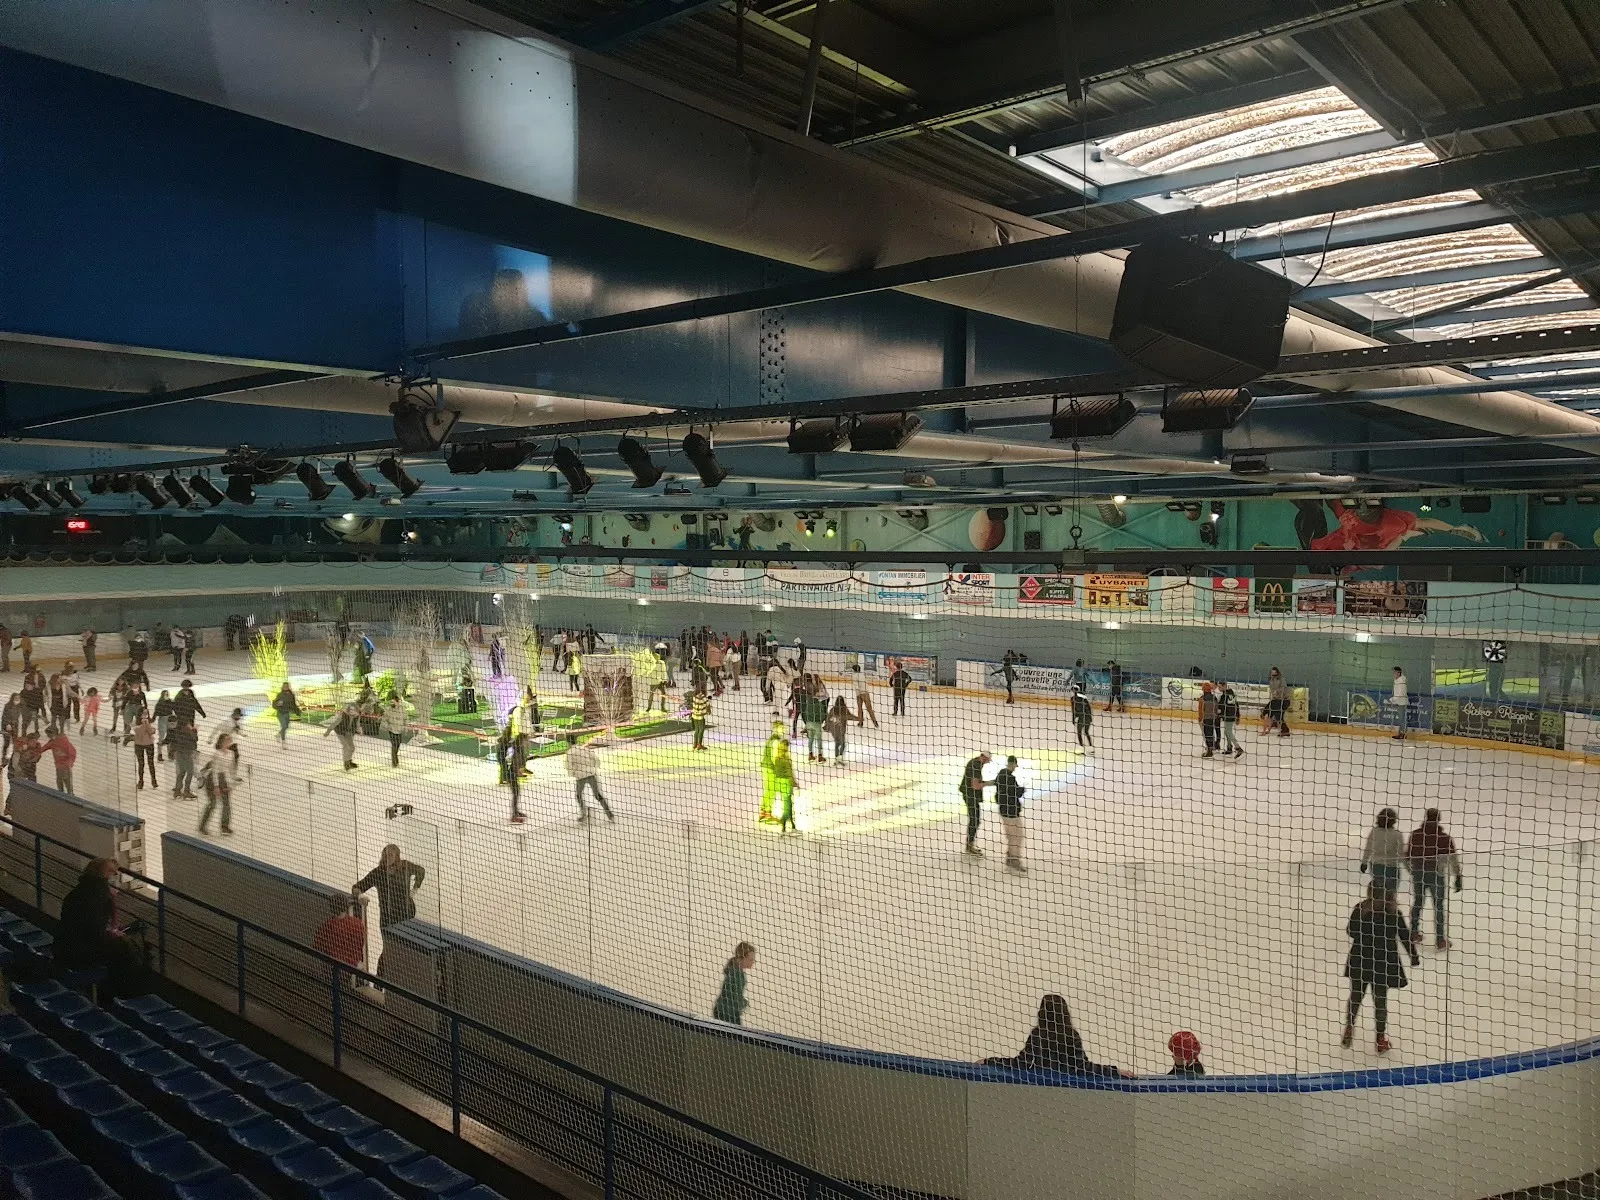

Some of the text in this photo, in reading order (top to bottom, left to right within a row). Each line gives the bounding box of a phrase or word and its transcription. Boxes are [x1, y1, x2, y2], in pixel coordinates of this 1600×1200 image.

[781, 583, 834, 592] PARTENAIRE
[1047, 671, 1063, 679] une
[1462, 702, 1493, 717] Bistro
[1542, 717, 1555, 728] 23
